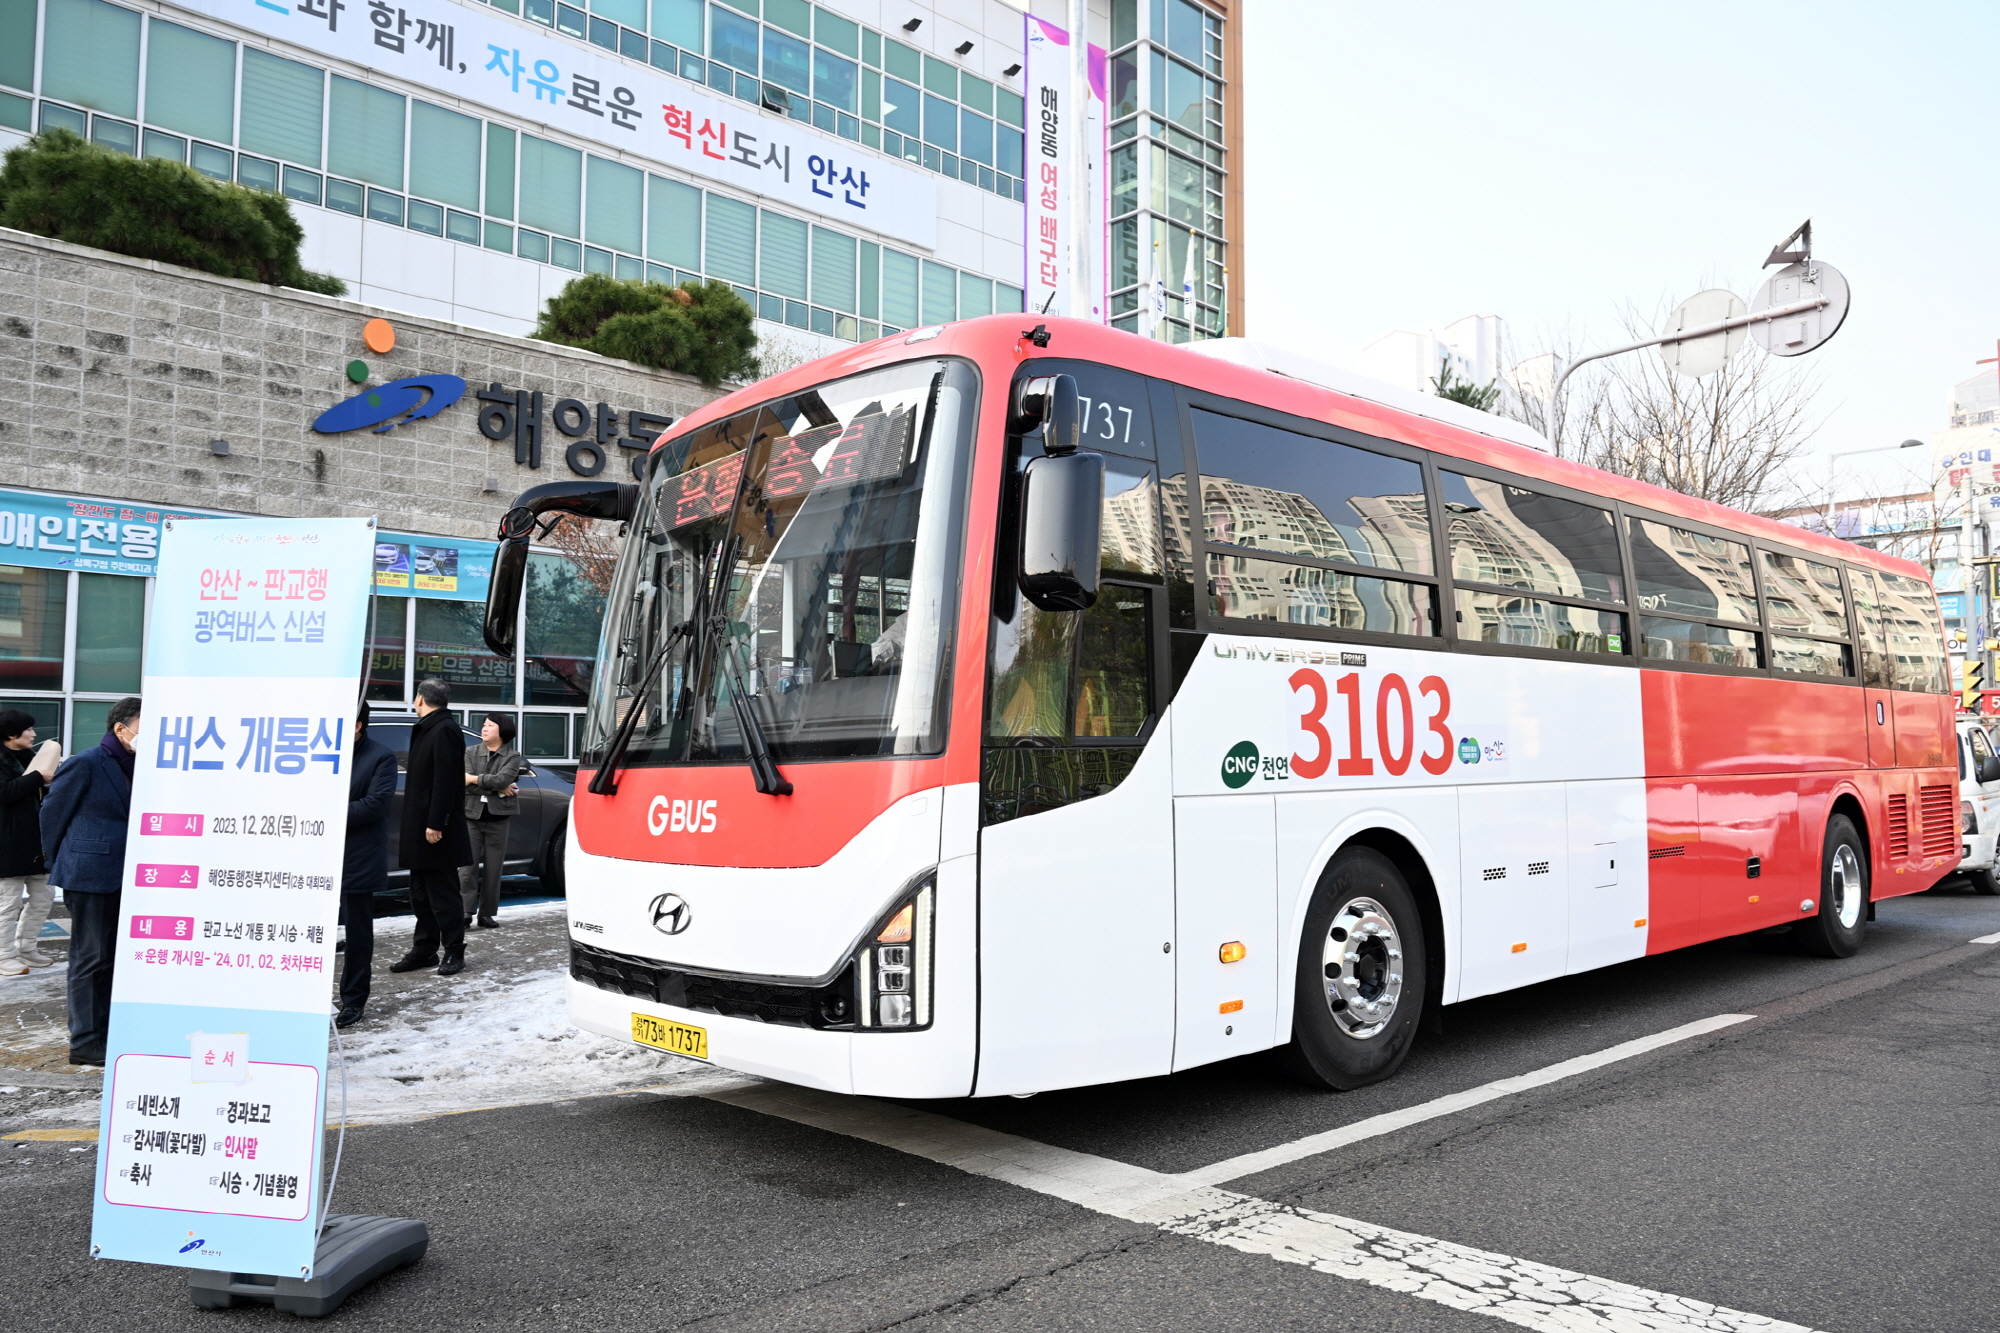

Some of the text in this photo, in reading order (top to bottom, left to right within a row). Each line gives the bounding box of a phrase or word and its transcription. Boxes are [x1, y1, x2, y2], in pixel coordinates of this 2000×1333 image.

[367, 0, 467, 74] 함께,
[484, 43, 642, 131] 자유로운
[661, 103, 790, 183] 혁신도시
[807, 154, 870, 209] 안산
[1041, 86, 1058, 158] 해양동
[1041, 162, 1057, 211] 여성
[1040, 215, 1057, 288] 배구단
[200, 568, 242, 601] 안산
[264, 567, 328, 602] 판교행
[195, 609, 326, 643] 광역버스 신설
[1213, 641, 1366, 666] UNIVERSE PRIME
[1288, 668, 1454, 779] 3103
[156, 716, 343, 775] 버스 개통식
[1225, 756, 1257, 773] CNG
[150, 815, 163, 832] 일
[185, 816, 197, 832] 시
[213, 817, 238, 835] 2023.
[242, 815, 258, 836] 12.
[300, 820, 325, 836] 10:00
[648, 794, 717, 837] GBUS
[144, 868, 158, 884] 장
[179, 870, 192, 884] 소
[139, 919, 153, 935] 내
[175, 920, 188, 936] 용
[203, 921, 221, 938] 판교
[223, 922, 243, 940] 노선
[245, 923, 264, 941] 개통
[267, 923, 276, 941] 및
[278, 924, 298, 943] 시승
[306, 926, 324, 943] 체험
[237, 954, 254, 969] 01.
[258, 954, 275, 970] 02.
[280, 955, 323, 973] 첫차부터
[669, 1025, 701, 1053] 1737
[204, 1050, 234, 1066] 순 서
[137, 1094, 180, 1119] 내빈소개
[227, 1101, 271, 1124] 경과보고
[134, 1129, 207, 1156] 감사패(꽃다발)
[224, 1135, 258, 1160] 인사말
[130, 1163, 152, 1186] 축사
[219, 1171, 242, 1194] 시승
[253, 1173, 298, 1199] 기념촬영
